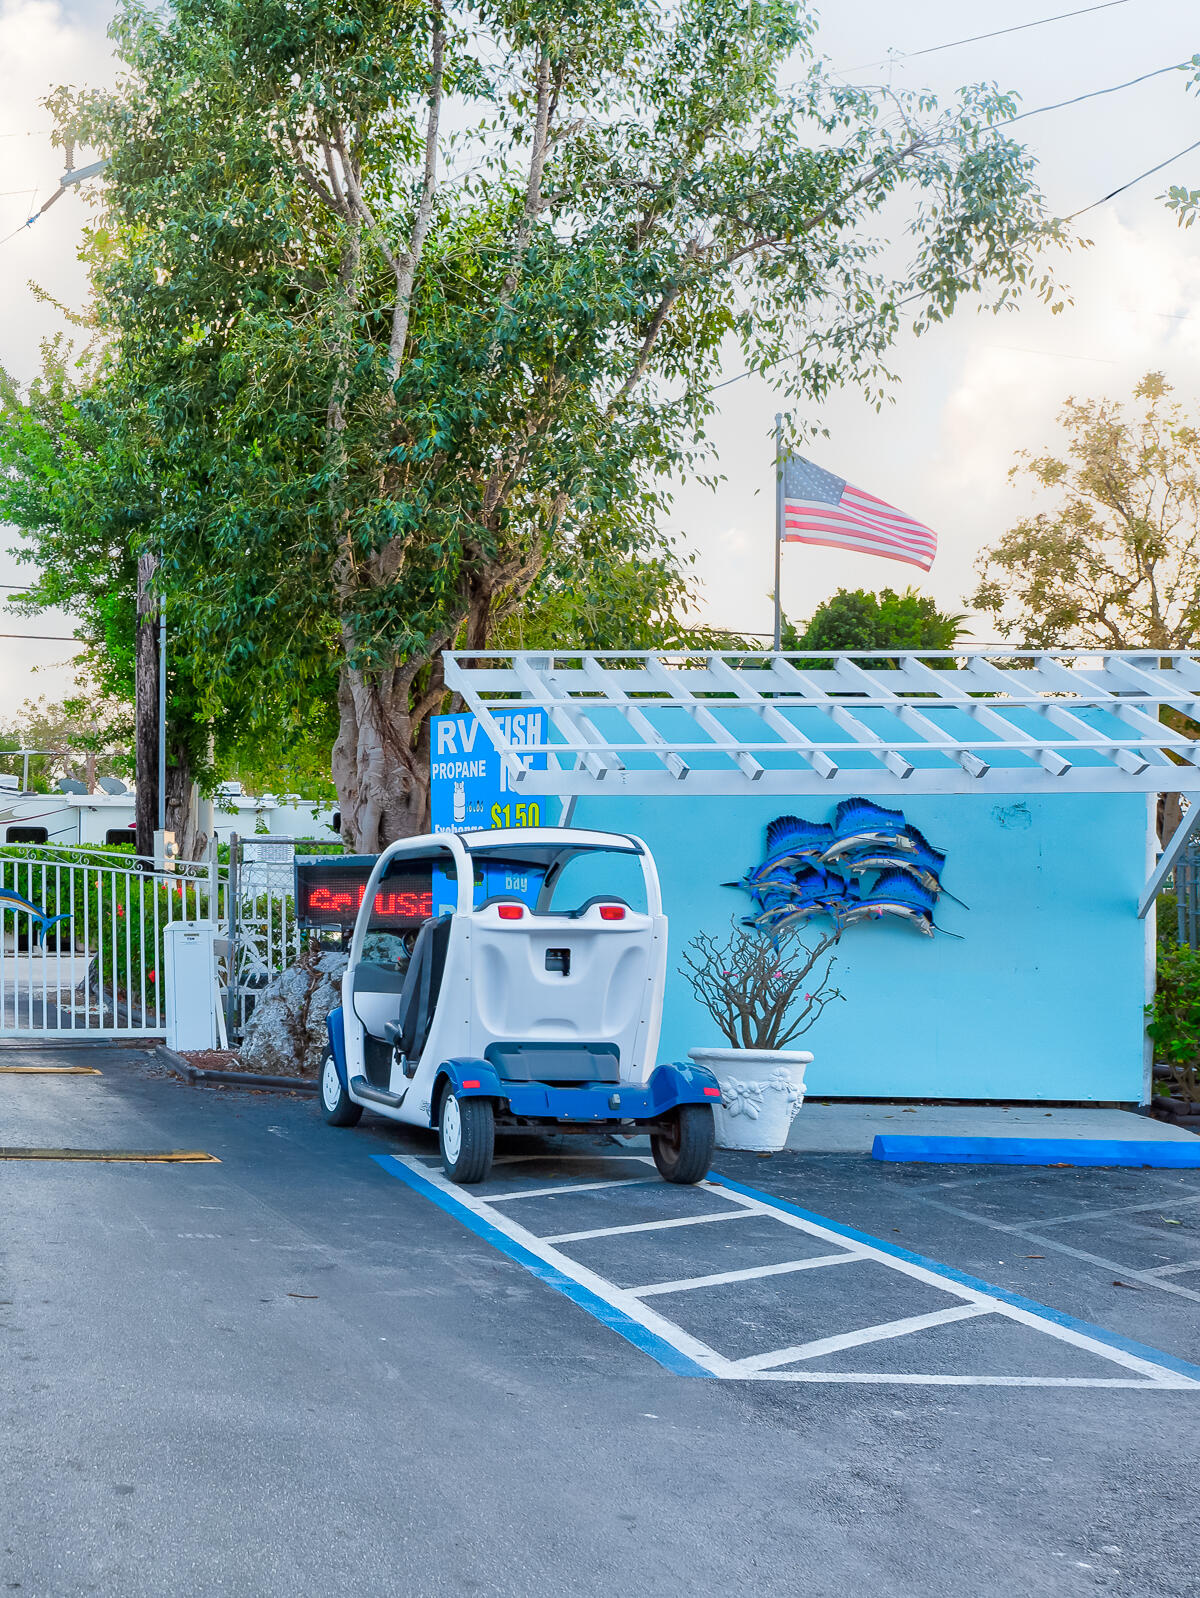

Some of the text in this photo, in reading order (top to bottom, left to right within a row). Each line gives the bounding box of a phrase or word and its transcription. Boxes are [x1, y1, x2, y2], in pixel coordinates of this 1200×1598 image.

[437, 718, 480, 756] RV
[432, 759, 487, 780] PROPANE
[505, 869, 528, 893] Bay
